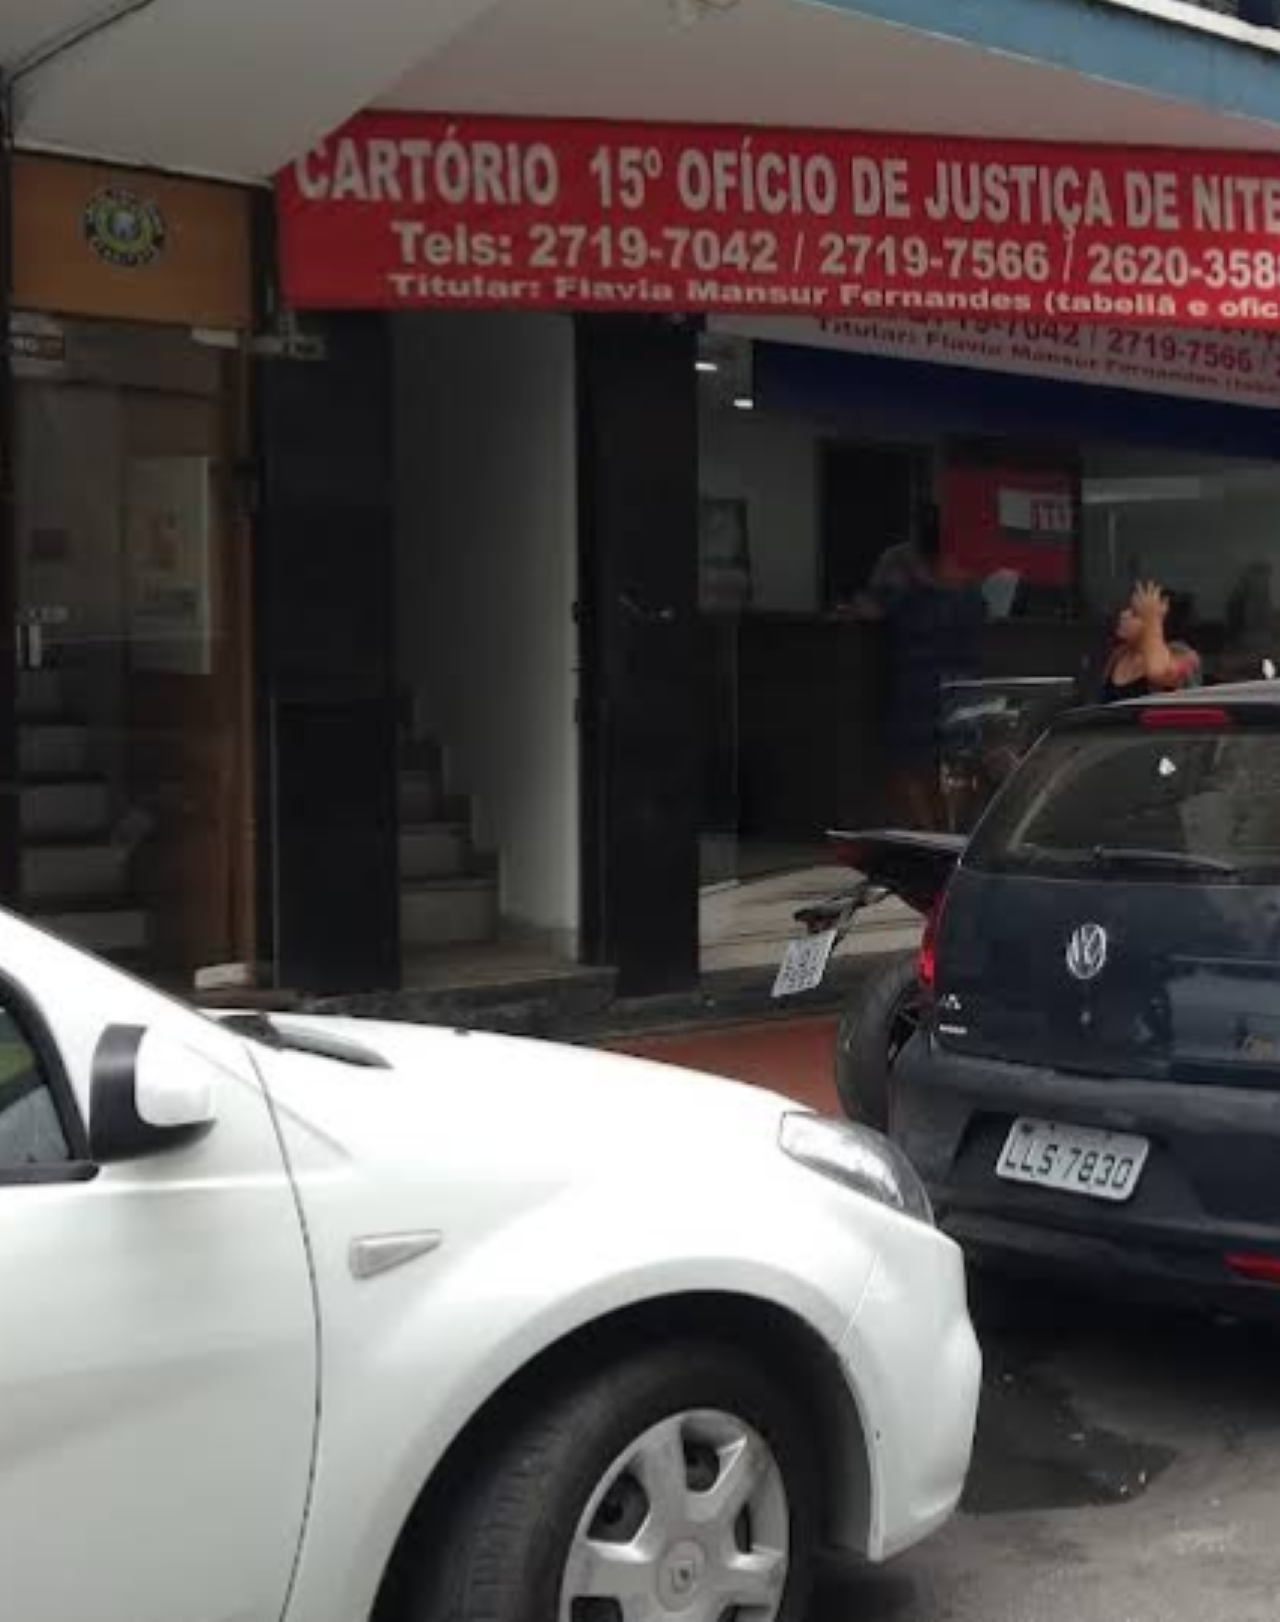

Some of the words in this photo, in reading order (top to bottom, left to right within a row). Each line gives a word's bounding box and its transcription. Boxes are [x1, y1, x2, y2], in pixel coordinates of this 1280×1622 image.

[293, 126, 558, 205] CARTÓRIO
[590, 146, 662, 208] 15º
[677, 138, 837, 216] OFÍCIO
[851, 157, 910, 218] DE
[924, 161, 1113, 240] JUSTIÇA
[1126, 172, 1179, 230] DE
[391, 221, 512, 266] Tels:
[528, 226, 777, 273] 2719-7042
[819, 234, 1048, 281] 2719-7566
[387, 273, 540, 298] Titular:
[554, 276, 673, 301] Flavia
[687, 280, 828, 305] Mansur
[840, 283, 1031, 310] Fernandes
[1188, 301, 1208, 317] e
[1108, 328, 1253, 371] 2719-7566
